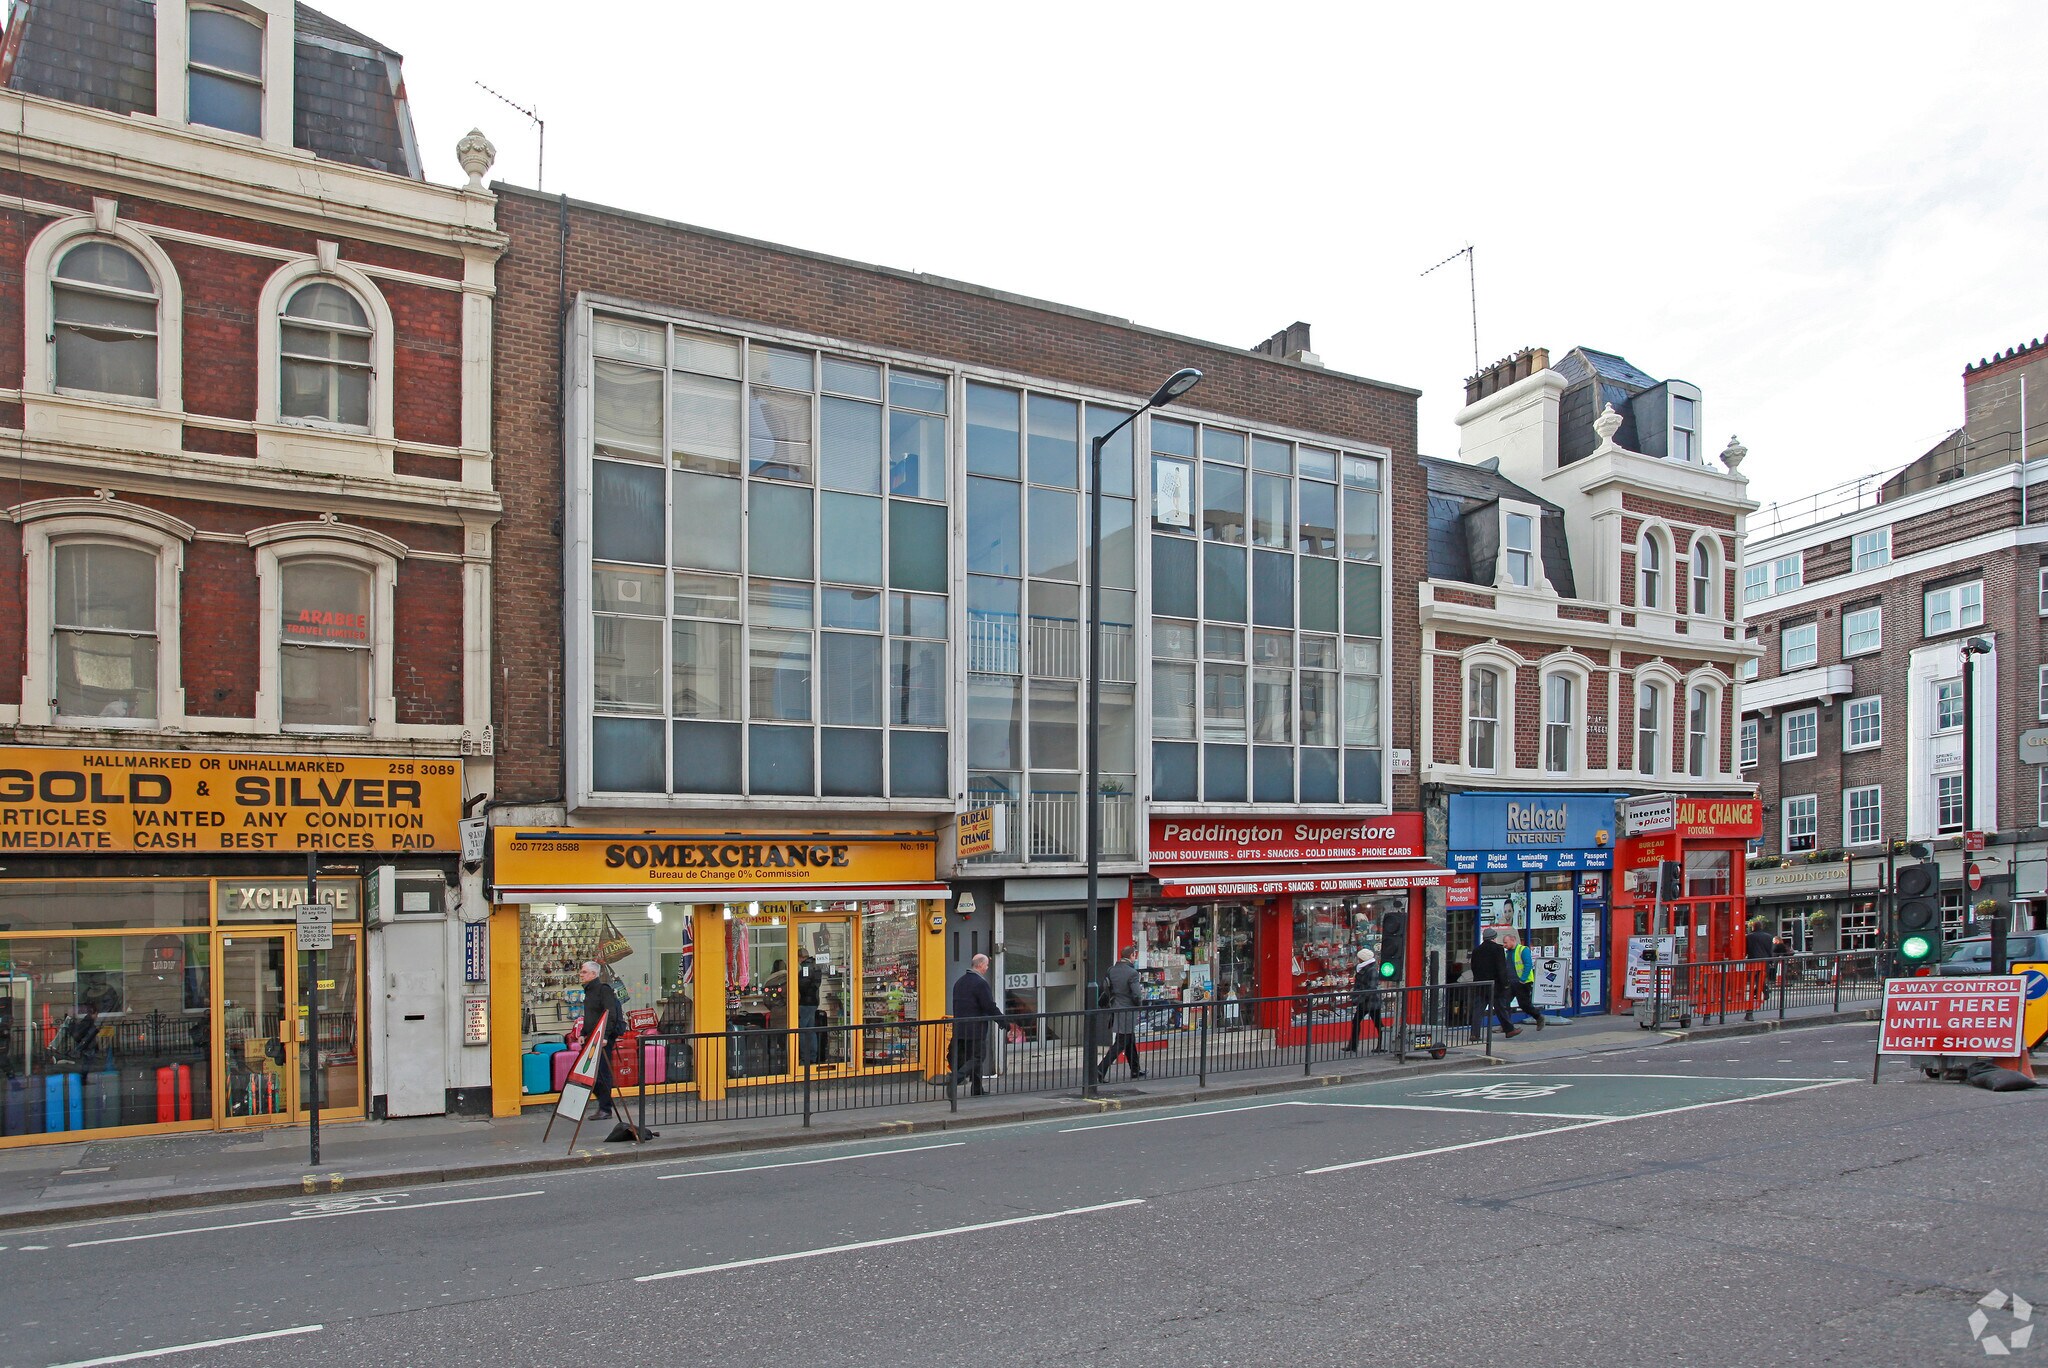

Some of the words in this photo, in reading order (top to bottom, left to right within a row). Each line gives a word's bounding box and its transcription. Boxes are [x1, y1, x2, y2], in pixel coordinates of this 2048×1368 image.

[298, 609, 365, 628] ARABEE
[286, 624, 323, 636] TRAVEL
[327, 628, 366, 640] LIMITED
[83, 756, 191, 769] HALLMARKED
[200, 758, 220, 770] OR
[228, 759, 344, 773] UNHALLMARKED
[389, 764, 414, 774] 258
[421, 764, 455, 775] 3089
[0, 769, 172, 804] GOLD
[196, 781, 210, 796] &
[235, 776, 421, 808] SILVER
[0, 809, 107, 826] RTICLES
[243, 811, 288, 827] ANY
[305, 812, 424, 829] CONDITION
[960, 809, 990, 827] BUREAU
[1507, 802, 1567, 831] Reload
[1629, 806, 1671, 819] internet
[1676, 803, 1695, 824] EAU
[1697, 808, 1707, 824] DE
[1709, 803, 1753, 825] CHANGE
[1643, 815, 1671, 827] place
[1163, 824, 1283, 845] Paddington
[1294, 824, 1396, 844] Superstore
[1687, 826, 1715, 835] FOTOFAST
[134, 831, 196, 848] CASH
[221, 832, 278, 848] BEST
[297, 833, 375, 849] PRICES
[392, 833, 435, 849] PAID
[960, 829, 991, 846] CHANGE
[1507, 832, 1566, 844] INTERNET
[1638, 840, 1665, 848] BUREAU
[510, 842, 528, 851] 020
[531, 842, 553, 851] 7723
[556, 843, 579, 852] 8588
[900, 842, 914, 850] No.
[916, 842, 929, 851] 191
[1148, 850, 1177, 860] ONDON
[1180, 850, 1229, 860] SOUVENIRS
[1237, 849, 1261, 859] GIFTS
[1267, 848, 1299, 858] SNACKS
[1305, 848, 1326, 858] COLD
[1327, 848, 1356, 857] DRINKS
[1361, 847, 1386, 856] PHONE
[1388, 847, 1412, 856] CARDS
[605, 844, 850, 869] SOMEXCHANGE
[1454, 853, 1478, 861] Internet
[1487, 853, 1507, 862] Digital
[1517, 853, 1548, 862] Laminating
[1583, 852, 1608, 860] Passport
[1637, 854, 1665, 863] CHANGE
[1457, 861, 1475, 869] Email
[1487, 860, 1508, 869] Photos
[1522, 861, 1543, 869] Binding
[1557, 859, 1576, 867] Center
[1586, 859, 1605, 867] Photos
[649, 870, 683, 879] Bureau
[686, 870, 698, 879] de
[700, 870, 736, 880] Change
[738, 869, 752, 878] 0%
[755, 869, 810, 879] Commission
[1755, 876, 1768, 886] OF
[1773, 868, 1848, 885] PADDINGTON
[1185, 885, 1216, 896] LONDON
[1218, 883, 1258, 894] SOUVENIRS
[1263, 882, 1283, 893] GIFTS
[1288, 881, 1315, 892] SNACKS
[1320, 880, 1337, 890] COLD
[1338, 879, 1362, 890] DRINKS
[1366, 879, 1387, 888] PHONE
[1388, 878, 1409, 887] CARDS
[1412, 877, 1440, 886] LUGGAGE
[1448, 886, 1471, 894] Passport
[1535, 903, 1557, 913] Reload
[1541, 912, 1567, 921] Wireless
[1008, 974, 1029, 988] 193
[1889, 982, 1938, 993] 4-WAY
[1942, 981, 2018, 992] CONTROL
[1896, 1000, 1940, 1011] WAIT
[1949, 999, 2010, 1012] HERE
[1890, 1018, 1942, 1029] UNTIL
[1947, 1016, 2013, 1029] GREEN
[1885, 1036, 1937, 1048] LIGHT
[1942, 1037, 2013, 1049] SHOWS
